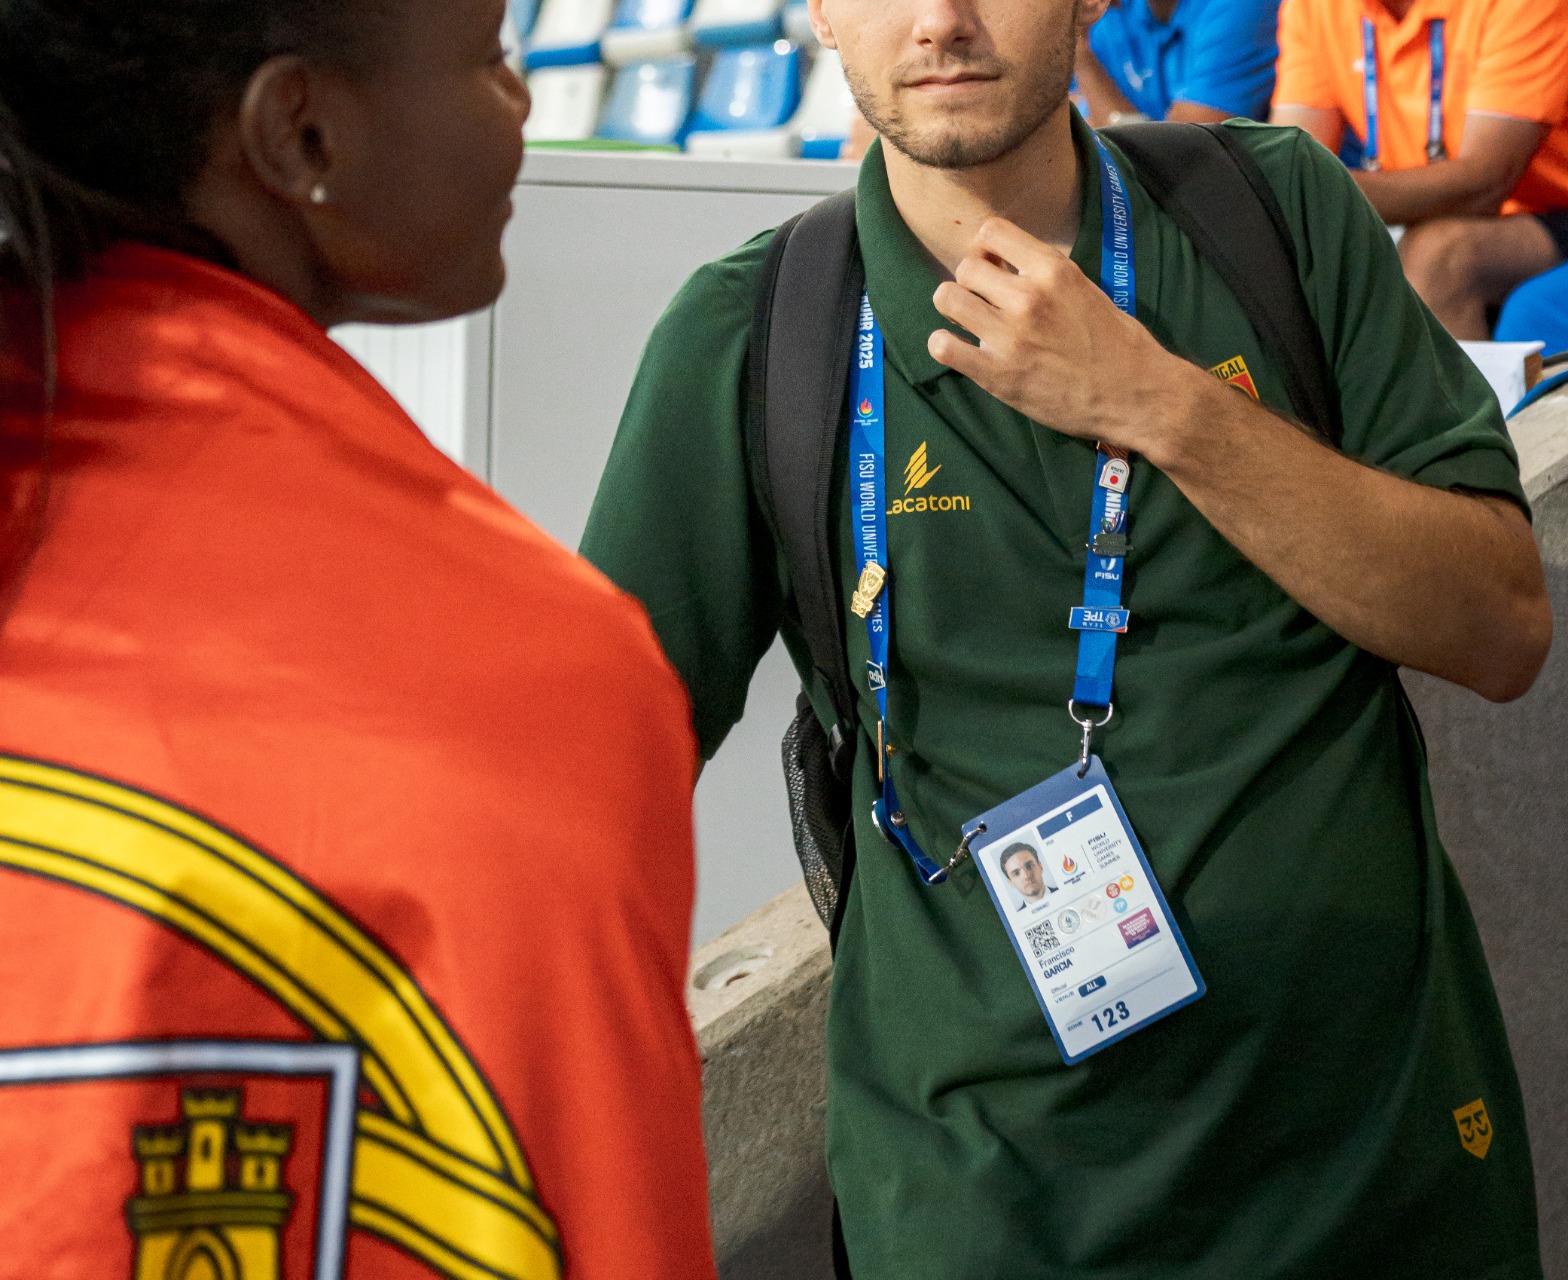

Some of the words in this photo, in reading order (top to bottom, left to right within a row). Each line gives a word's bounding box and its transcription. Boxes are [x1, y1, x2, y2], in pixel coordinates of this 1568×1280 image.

[1105, 164, 1122, 194] GAMES
[1110, 192, 1128, 250] UNIVERSITY
[1114, 252, 1129, 287] WORLD
[859, 333, 874, 369] 2025
[859, 453, 875, 479] FISU
[859, 481, 876, 521] WORLD
[1095, 572, 1119, 580] FISU
[1083, 610, 1104, 622] TPE
[1065, 811, 1073, 822] F
[1088, 832, 1106, 845] FISU
[1091, 839, 1110, 851] WORLD
[1038, 946, 1075, 969] Francisco
[1043, 958, 1073, 979] GARCIA
[1086, 980, 1099, 992] ALL
